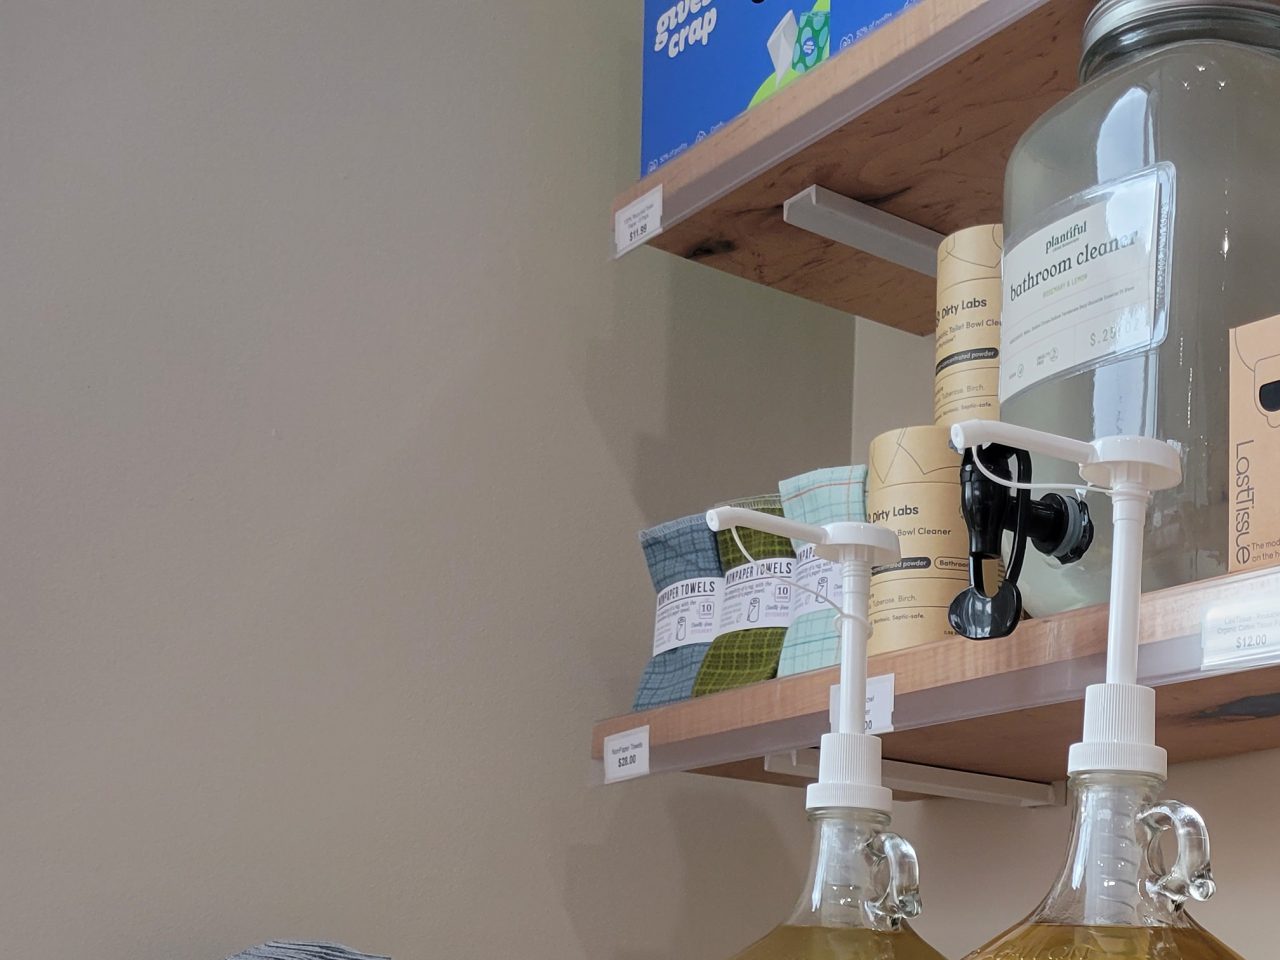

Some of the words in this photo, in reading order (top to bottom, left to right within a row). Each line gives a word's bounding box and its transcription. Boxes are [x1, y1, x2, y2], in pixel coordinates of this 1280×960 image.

[668, 8, 717, 58] crap
[1045, 221, 1087, 254] plantiful
[1076, 231, 1139, 265] cleaner
[1010, 257, 1072, 301] bathroom
[941, 304, 959, 319] Dirty
[961, 298, 987, 310] Labs
[966, 319, 984, 329] Bowl
[872, 510, 890, 524] Dirty
[893, 504, 919, 517] Labs
[897, 527, 916, 537] Bowl
[917, 527, 951, 536] Cleaner
[1252, 542, 1264, 551] The
[1262, 551, 1273, 560] the
[902, 560, 927, 568] powder
[726, 566, 754, 585] NONPAPER
[756, 562, 792, 576] TOWELS
[681, 581, 715, 595] TOWELS
[777, 587, 788, 595] 10
[702, 604, 712, 612] 10
[1236, 633, 1267, 649] $12.00
